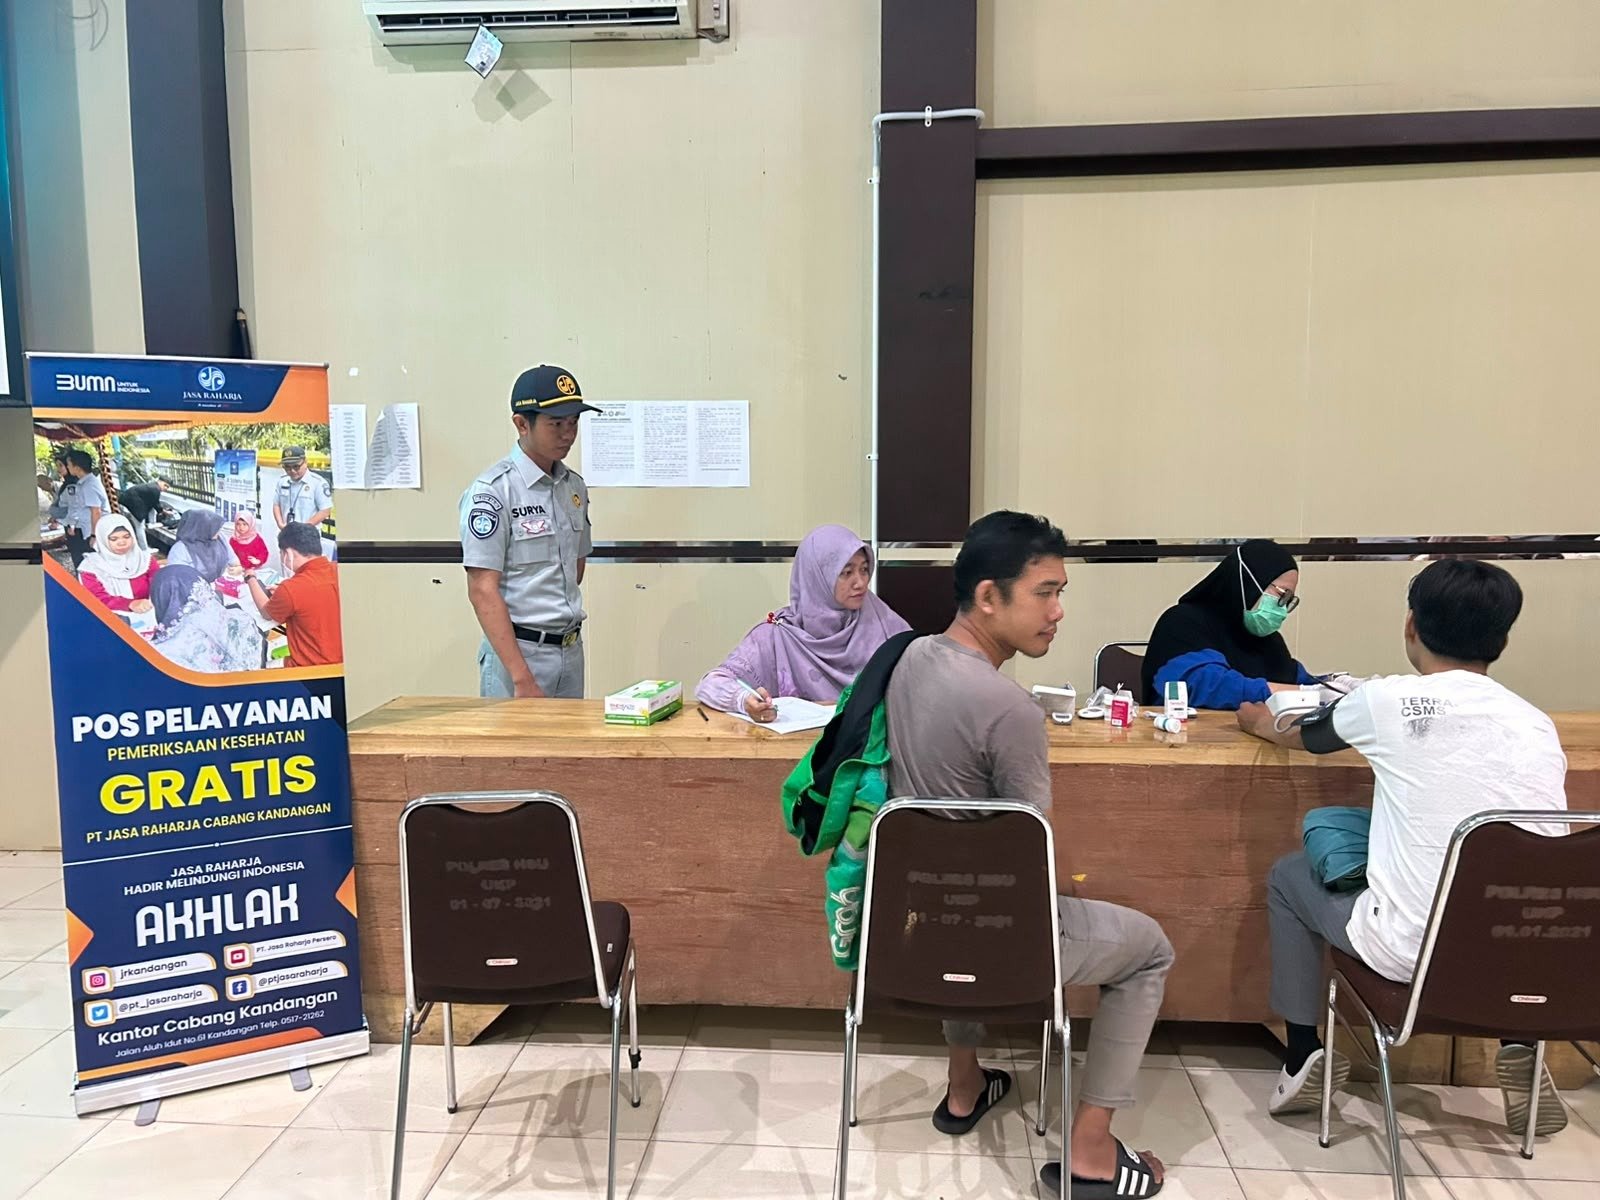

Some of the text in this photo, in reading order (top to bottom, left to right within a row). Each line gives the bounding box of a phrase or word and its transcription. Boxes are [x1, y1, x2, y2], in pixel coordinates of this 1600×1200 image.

[56, 374, 116, 392] BUMN
[183, 391, 242, 401] JASA RAHARJA
[511, 504, 546, 518] SURYA
[72, 695, 332, 743] POS PELAYANAN
[1401, 705, 1446, 717] CSMS
[107, 729, 305, 761] PEMERIKSAAN KESEHATAN
[100, 755, 317, 815] GRATIS
[86, 802, 331, 843] PT JASA RAHARJA CABANG KANDANGAN
[123, 860, 305, 896] HADIR MELINDUNGI INDONESIA
[170, 856, 262, 878] JASA RAHARJA
[135, 882, 299, 948] AKHLAK
[267, 943, 284, 951] Jasa
[285, 938, 312, 949] Raharja
[312, 935, 337, 944] Persero
[120, 960, 188, 980] jrkandangan
[258, 967, 329, 987] @ptjasaraharja
[118, 989, 203, 1012] @pt_jasaraharja
[98, 990, 338, 1046] Kantor Cabang Kandangan
[115, 1046, 141, 1058] Jalan
[142, 1041, 163, 1053] Aluh
[164, 1037, 182, 1048] Idut
[207, 1024, 259, 1040] Kandangan
[260, 1019, 280, 1031] Telp.
[280, 1010, 325, 1026] 0517-21262
